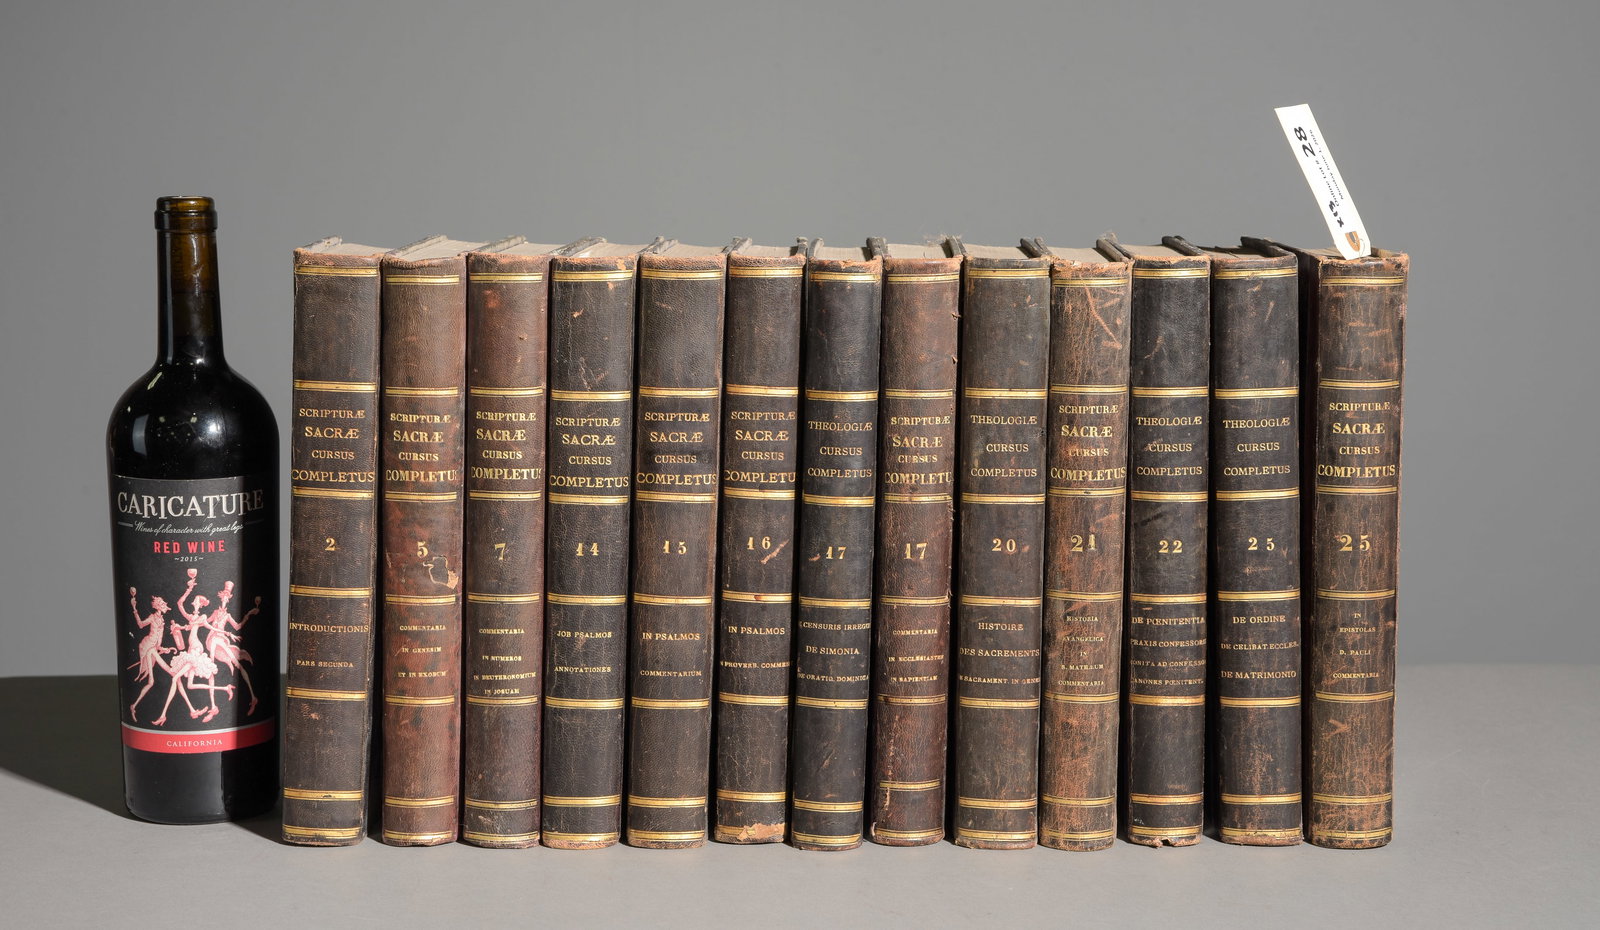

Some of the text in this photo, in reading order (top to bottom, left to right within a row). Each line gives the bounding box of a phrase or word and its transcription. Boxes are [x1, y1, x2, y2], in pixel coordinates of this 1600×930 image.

[1294, 126, 1316, 157] 28
[1059, 405, 1118, 414] SCRIPTURÆ
[1329, 402, 1390, 412] SCRIPTURÆ
[300, 408, 365, 419] SCRIPTURÆ
[390, 413, 451, 424] SCRIPTURÆ
[476, 411, 536, 421] SCRIPTURÆ
[644, 412, 710, 422] SCRIPTURÆ
[731, 411, 796, 421] SCRIPTURÆ
[556, 417, 621, 427] SCRIPTURÆ
[891, 416, 951, 426] SCRIPTURÆ
[970, 415, 1038, 425] THEOLOGIÆ
[1136, 416, 1202, 426] THEOLOGIÆ
[1223, 418, 1290, 428] THEOLOGIÆ
[808, 421, 872, 432] THEOLOGIÆ
[1061, 425, 1113, 437] SACRÆ
[1332, 422, 1385, 434] SACRÆ
[304, 426, 359, 439] SACRÆ
[393, 431, 444, 442] SACRÆ
[476, 428, 526, 441] SACRÆ
[650, 432, 704, 443] SACRÆ
[735, 430, 789, 441] SACRÆ
[562, 434, 616, 446] SACRÆ
[892, 436, 942, 448] SACRÆ
[820, 447, 862, 456] CURSUS
[986, 444, 1029, 453] CURSUS
[1149, 443, 1192, 452] CURSUS
[1237, 442, 1280, 452] CURSUS
[1339, 446, 1380, 455] CURSUS
[312, 450, 355, 460] CURSUS
[398, 452, 439, 462] CURSUS
[482, 450, 523, 460] CURSUS
[741, 451, 784, 461] CURSUS
[1068, 448, 1109, 457] CURSUS
[569, 456, 612, 465] CURSUS
[655, 455, 697, 464] CURSUS
[898, 454, 938, 464] CURSUS
[291, 469, 375, 482] COMPLETUS
[808, 468, 872, 478] COMPLETUS
[970, 468, 1037, 477] COMPLETUS
[1051, 466, 1126, 480] COMPLETUS
[1136, 466, 1202, 476] COMPLETUS
[1224, 466, 1290, 476] COMPLETUS
[1318, 464, 1396, 478] COMPLETUS
[550, 475, 629, 488] COMPLETUS
[636, 472, 717, 485] COMPLETUS
[118, 490, 264, 519] CARICATURE
[134, 520, 243, 536] Wines of character with great legs
[154, 540, 225, 553] RED WINE
[325, 538, 336, 551] 2
[992, 539, 1016, 552] 20
[1071, 534, 1096, 552] 21
[1159, 540, 1183, 553] 22
[417, 542, 429, 558] 5
[495, 543, 506, 560] 7
[825, 546, 847, 559] 17
[904, 542, 928, 560] 17
[1233, 616, 1286, 624] DE ORDINE
[289, 622, 369, 632] INTRODUCTIONIS
[728, 626, 786, 635] IN PSALMOS
[803, 622, 842, 630] CENSURIS
[978, 623, 1024, 631] HISTOIRE
[574, 631, 612, 639] PSALMOS
[642, 632, 701, 641] IN PSALMOS
[820, 647, 860, 655] SIMONIA
[978, 649, 1040, 657] SACREMENTS
[1236, 671, 1296, 679] MATRIMONIO
[166, 739, 223, 747] CALIFORNIA
